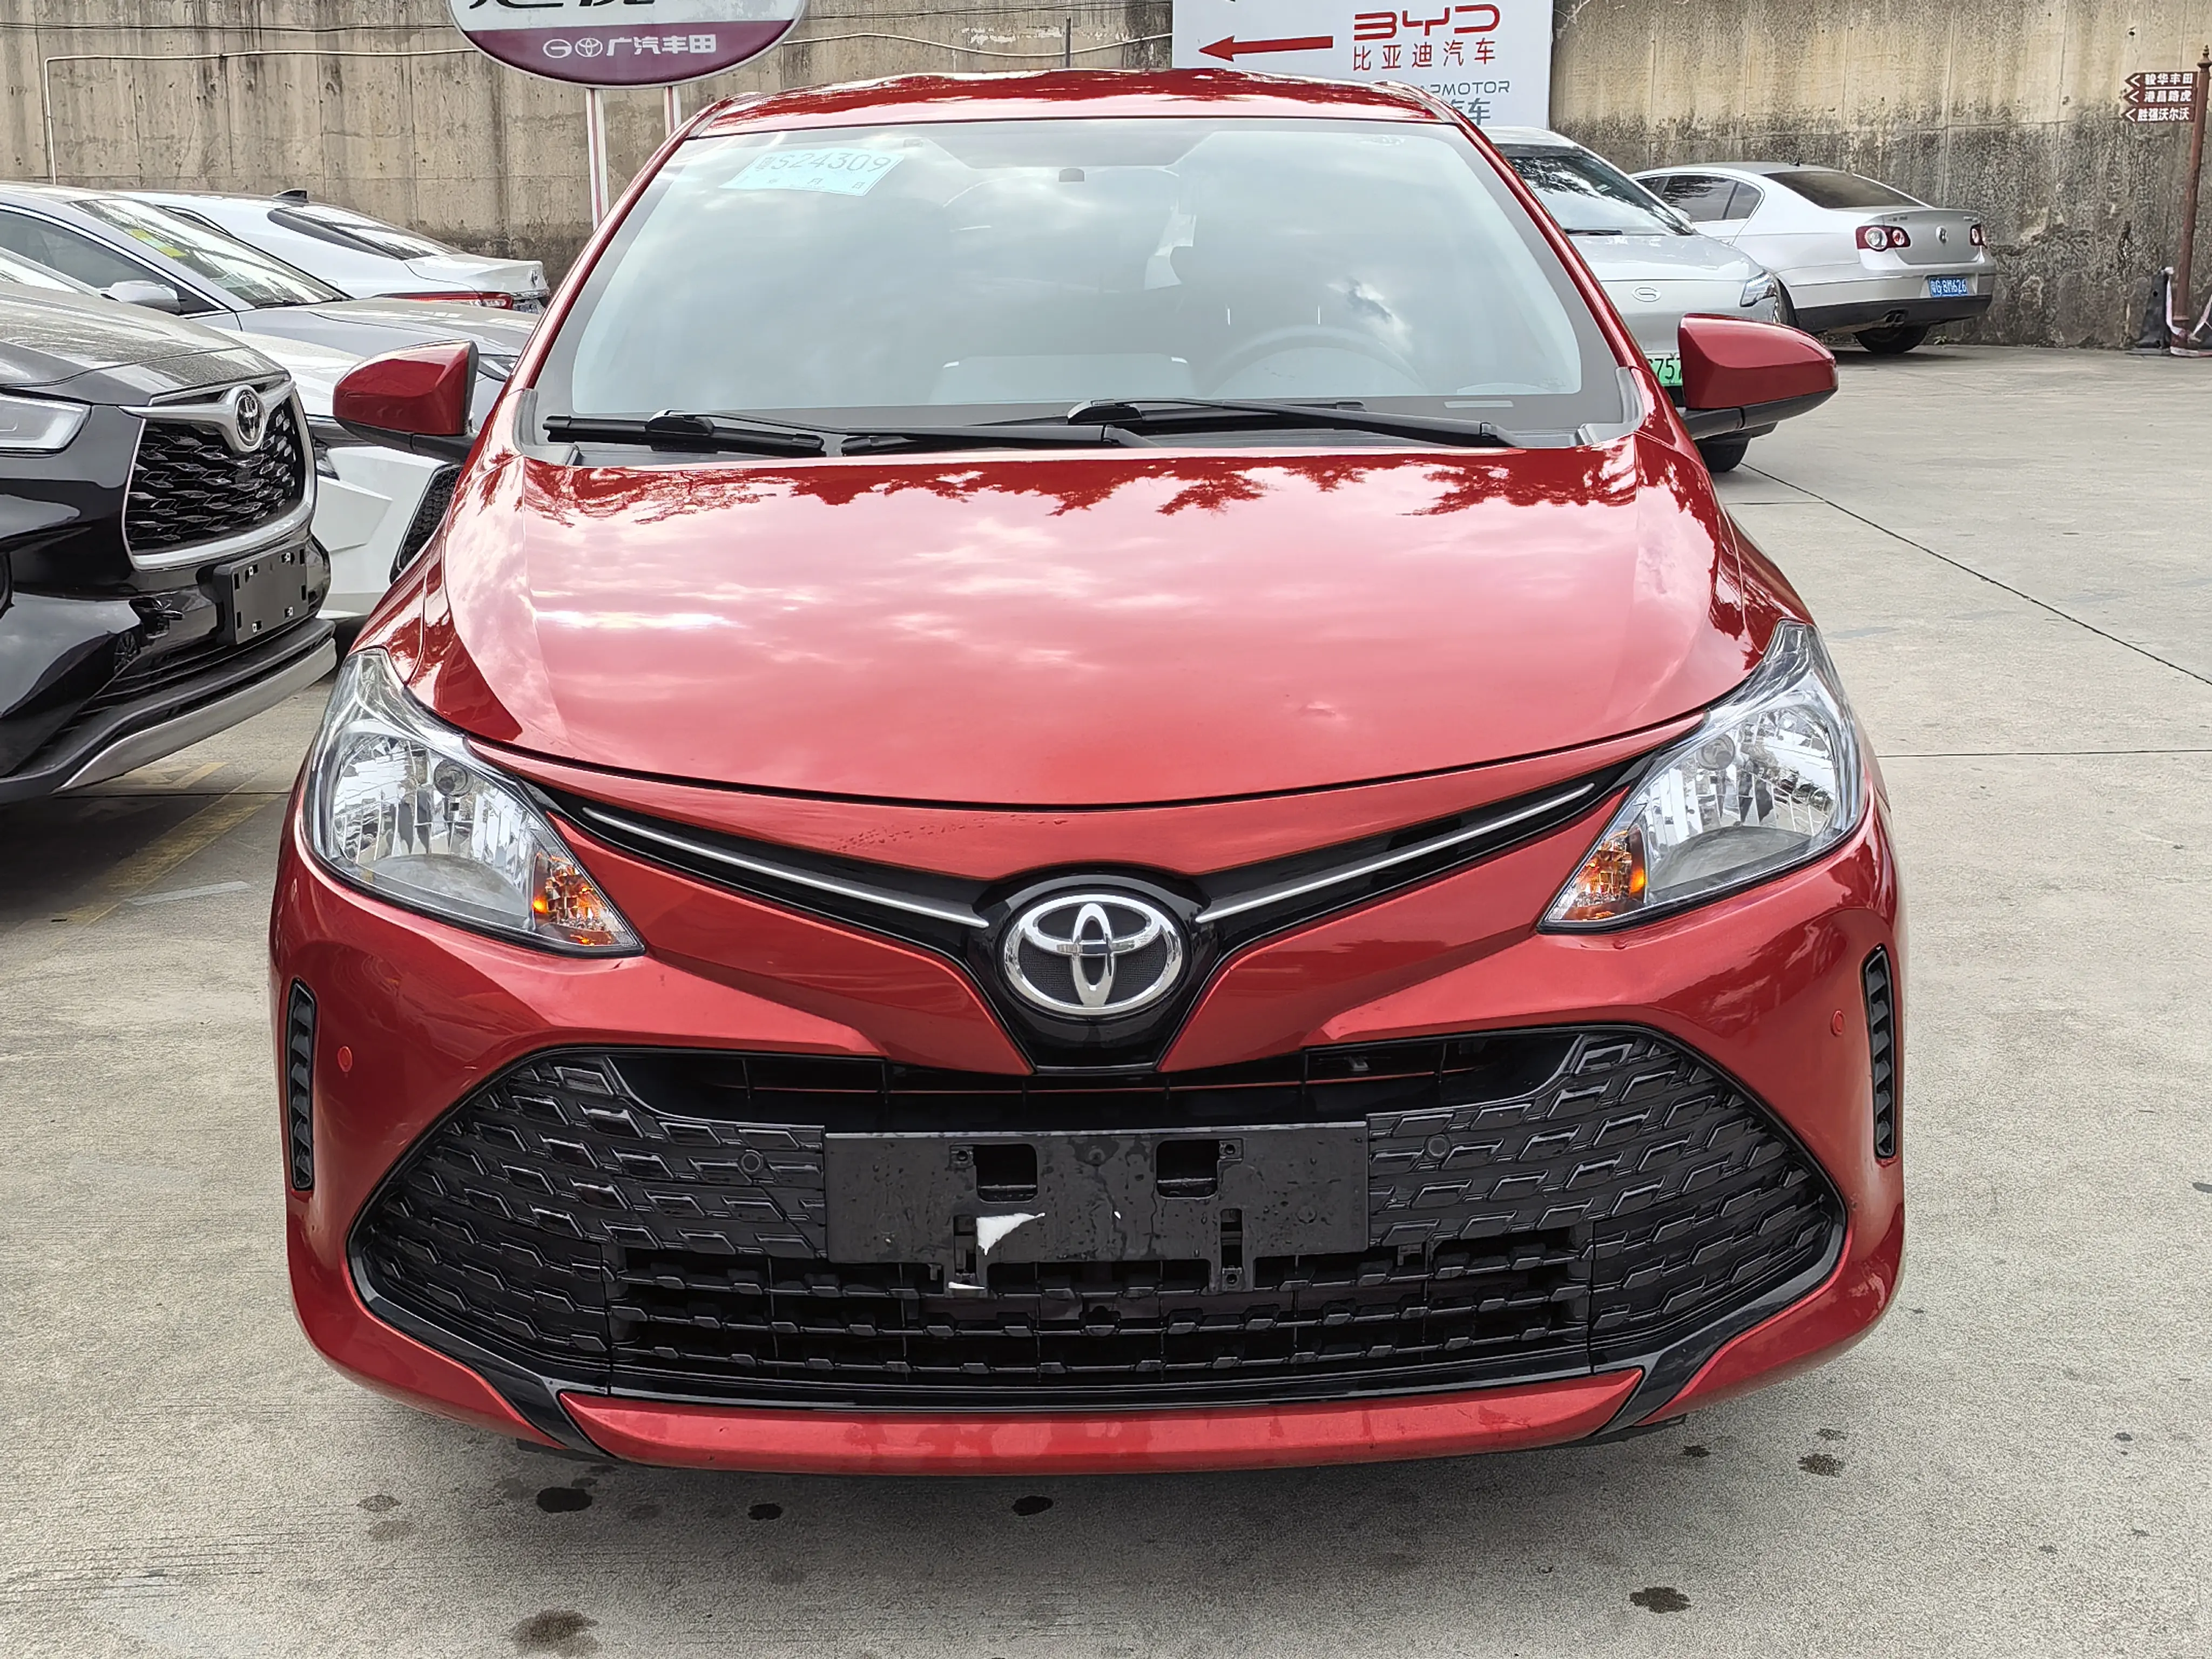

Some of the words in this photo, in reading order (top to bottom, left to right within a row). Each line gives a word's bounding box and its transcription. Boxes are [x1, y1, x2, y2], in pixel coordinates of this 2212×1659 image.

[1354, 4, 1500, 41] BYD
[606, 35, 717, 56] 广汽丰田
[1353, 37, 1496, 71] 比亚迪汽车
[1420, 80, 1510, 96] PMOTOR
